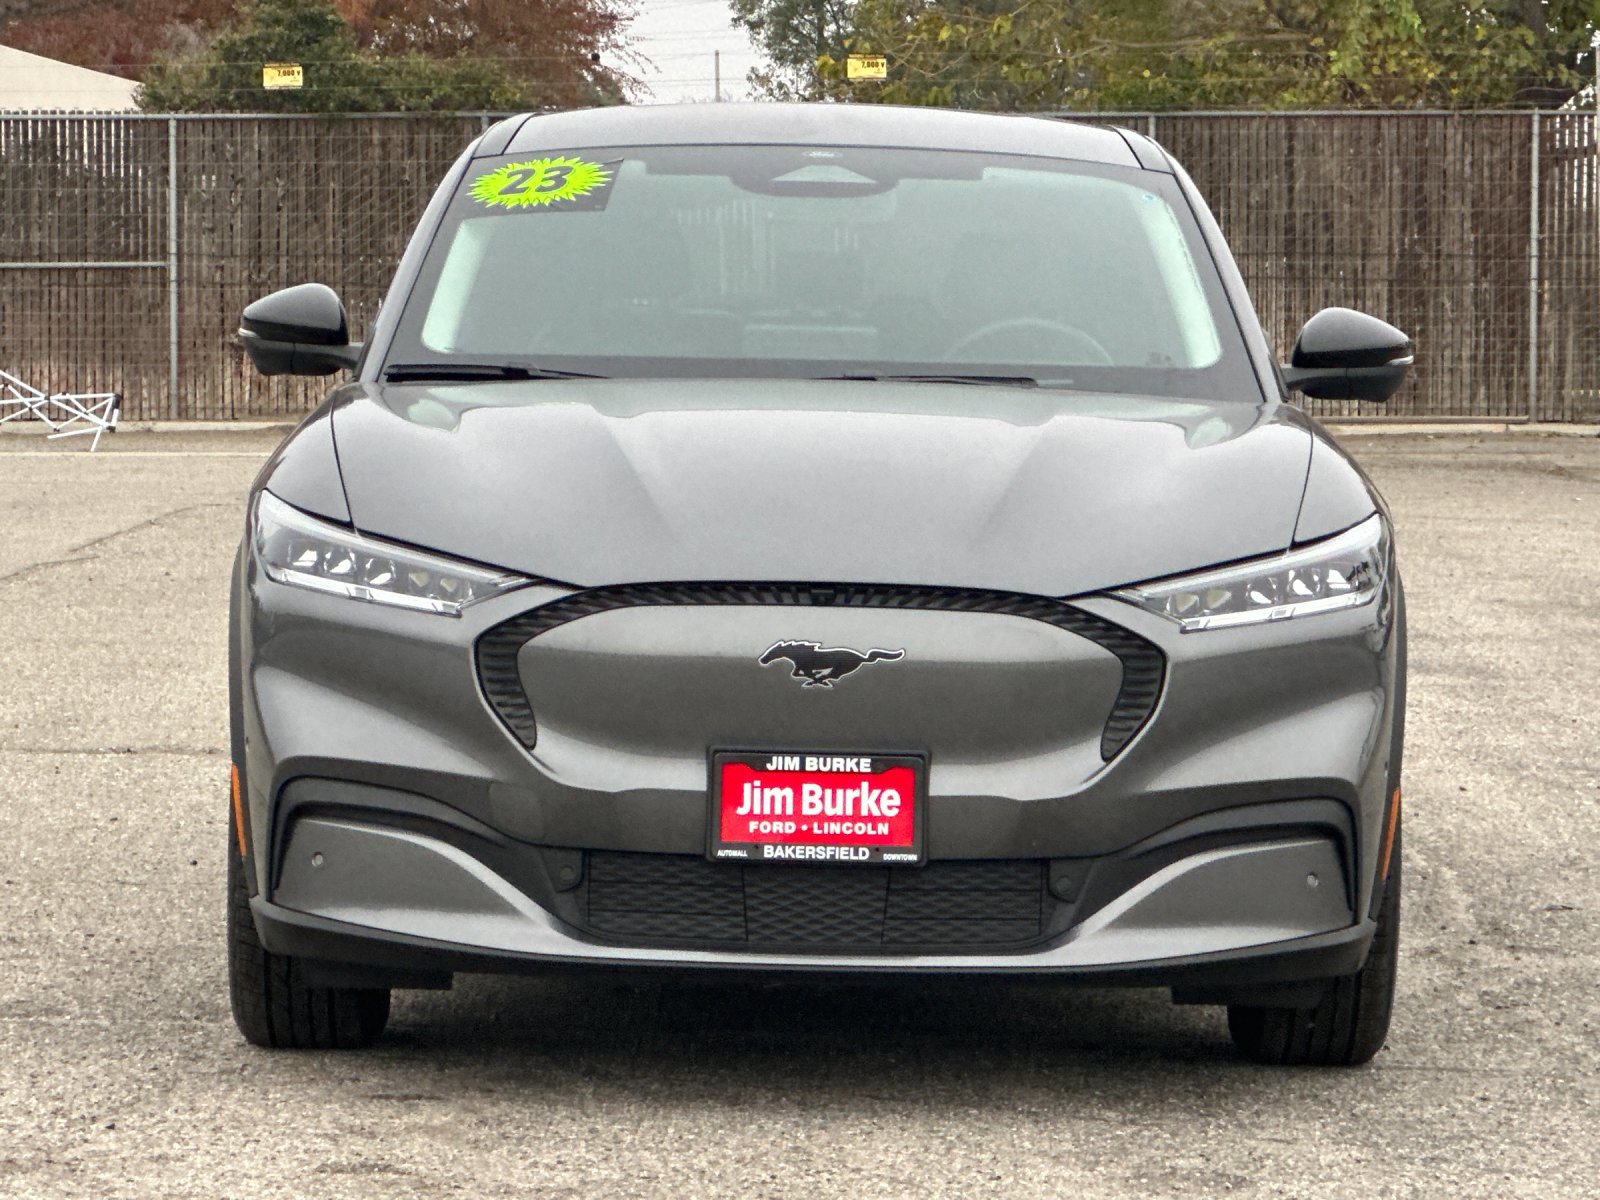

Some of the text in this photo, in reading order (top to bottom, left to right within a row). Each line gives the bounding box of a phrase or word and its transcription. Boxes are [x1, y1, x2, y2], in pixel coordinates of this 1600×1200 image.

[499, 166, 574, 195] 23
[766, 756, 871, 773] JIM BURKE
[736, 780, 901, 817] Jim Burke
[749, 821, 889, 835] FORD LINCOLN
[717, 849, 748, 857] AUTOMALL
[763, 845, 869, 860] BAKERSFIELD
[883, 853, 918, 861] DOWNTOWN
